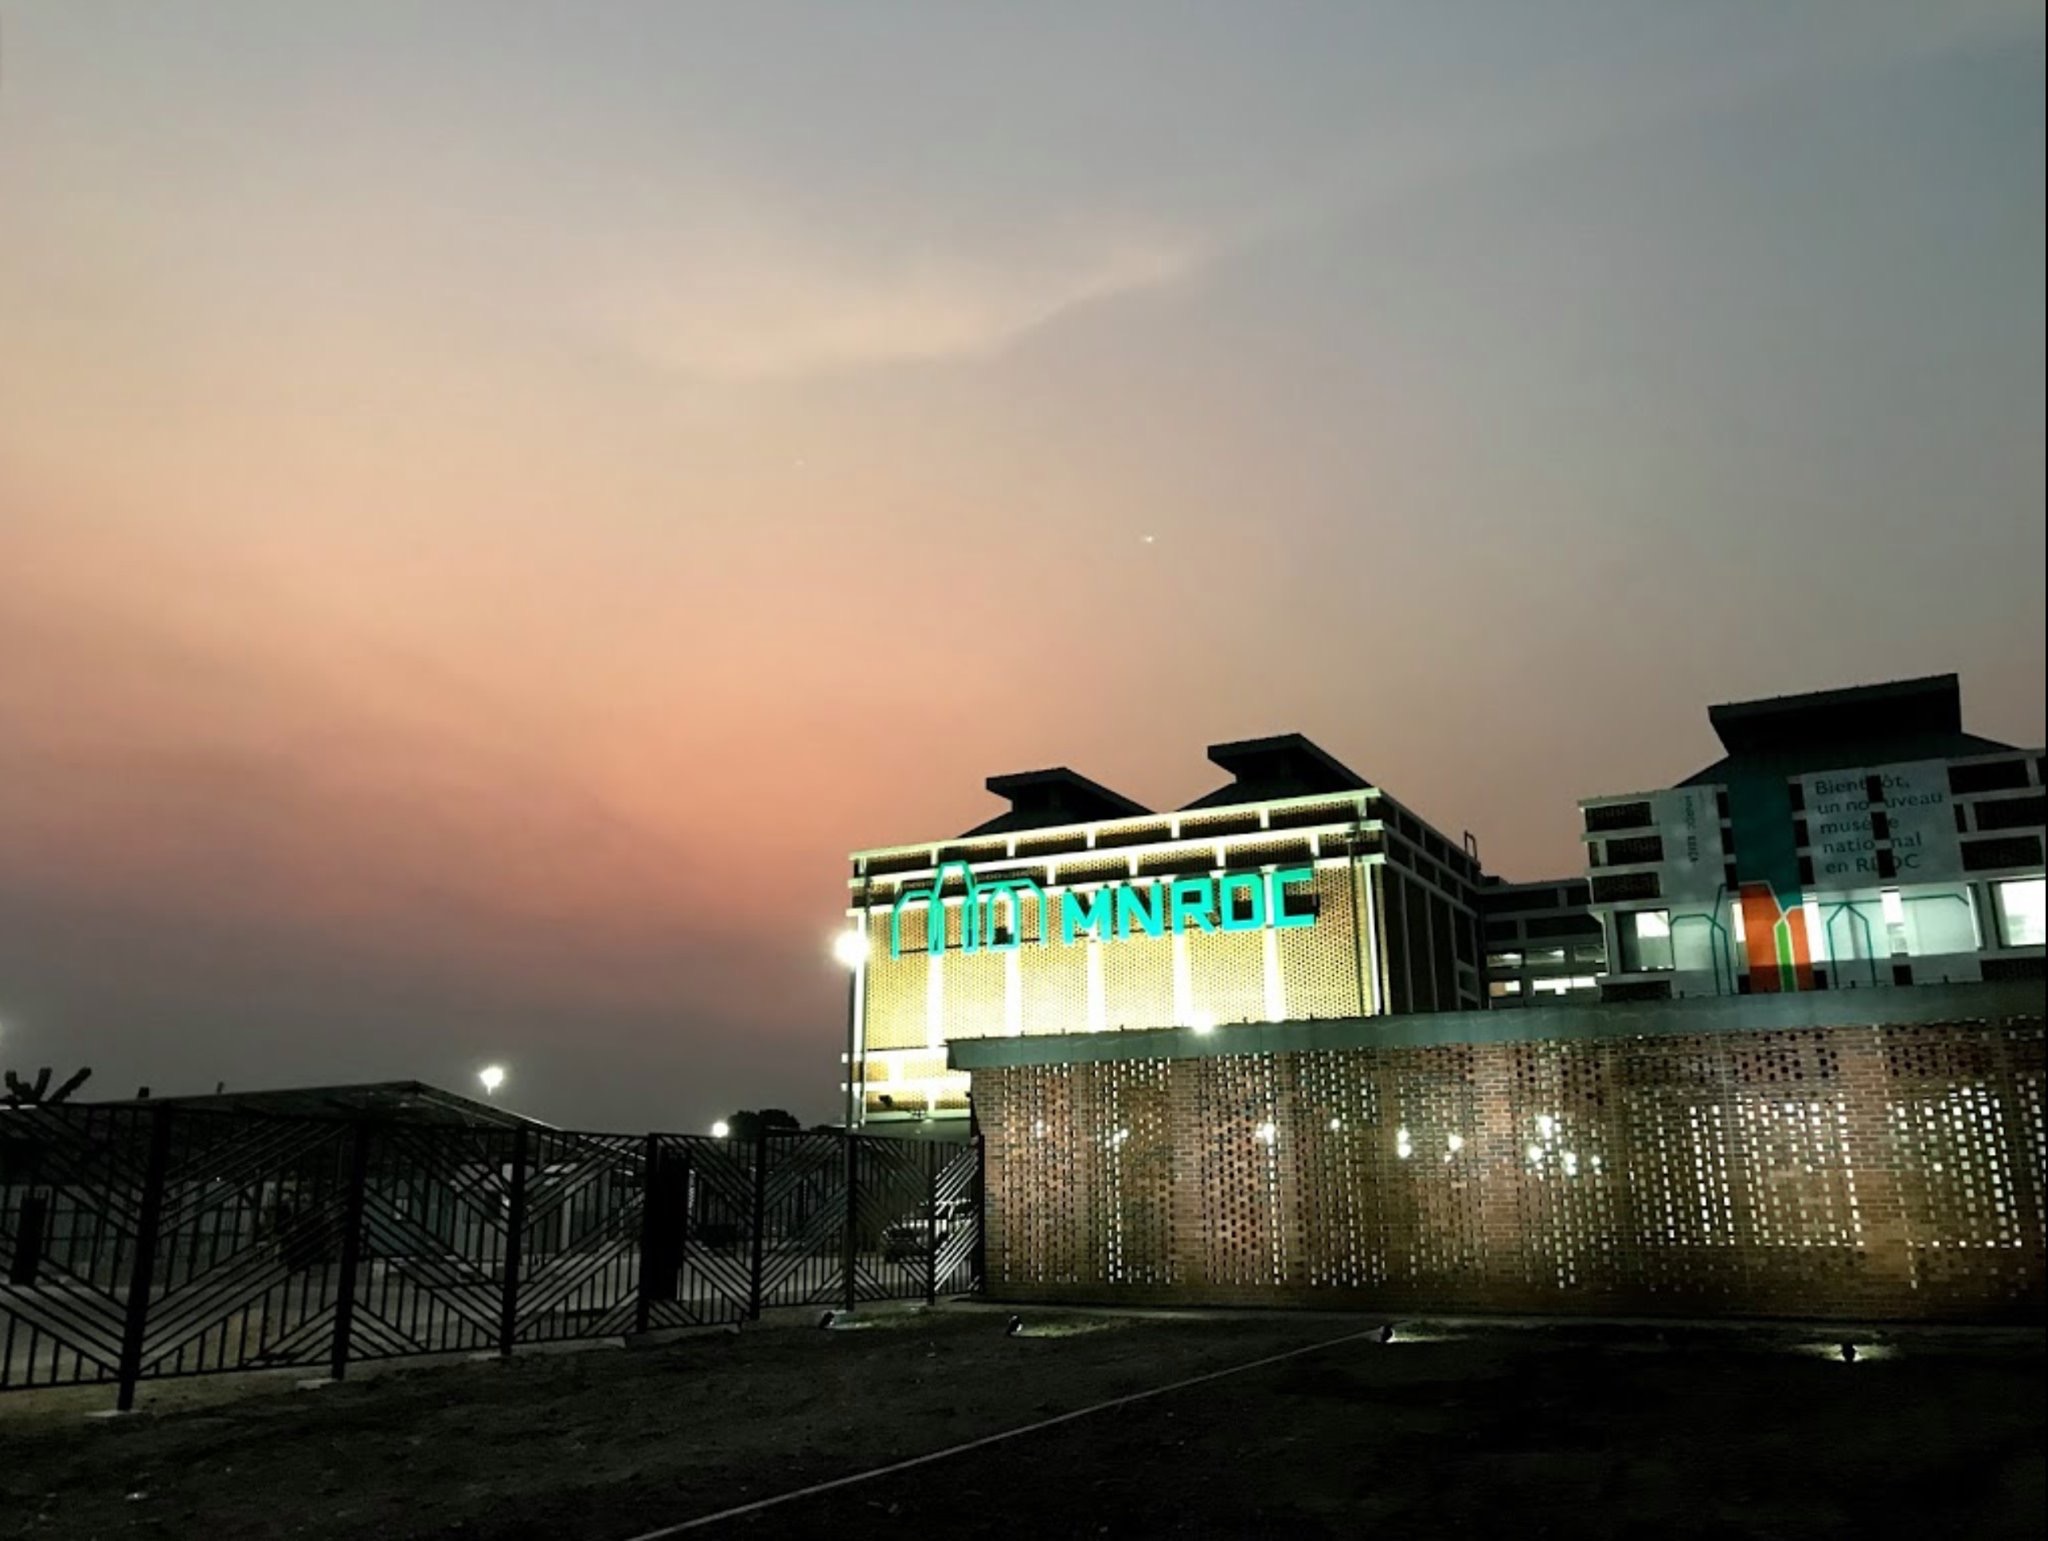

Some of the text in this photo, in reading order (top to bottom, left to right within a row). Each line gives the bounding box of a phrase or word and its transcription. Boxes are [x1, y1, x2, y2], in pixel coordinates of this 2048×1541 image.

[1817, 791, 1943, 815] un nouveau
[1819, 816, 1900, 835] musée
[1823, 831, 1922, 854] national
[1825, 862, 1849, 875] en
[1062, 868, 1316, 945] MNRDC
